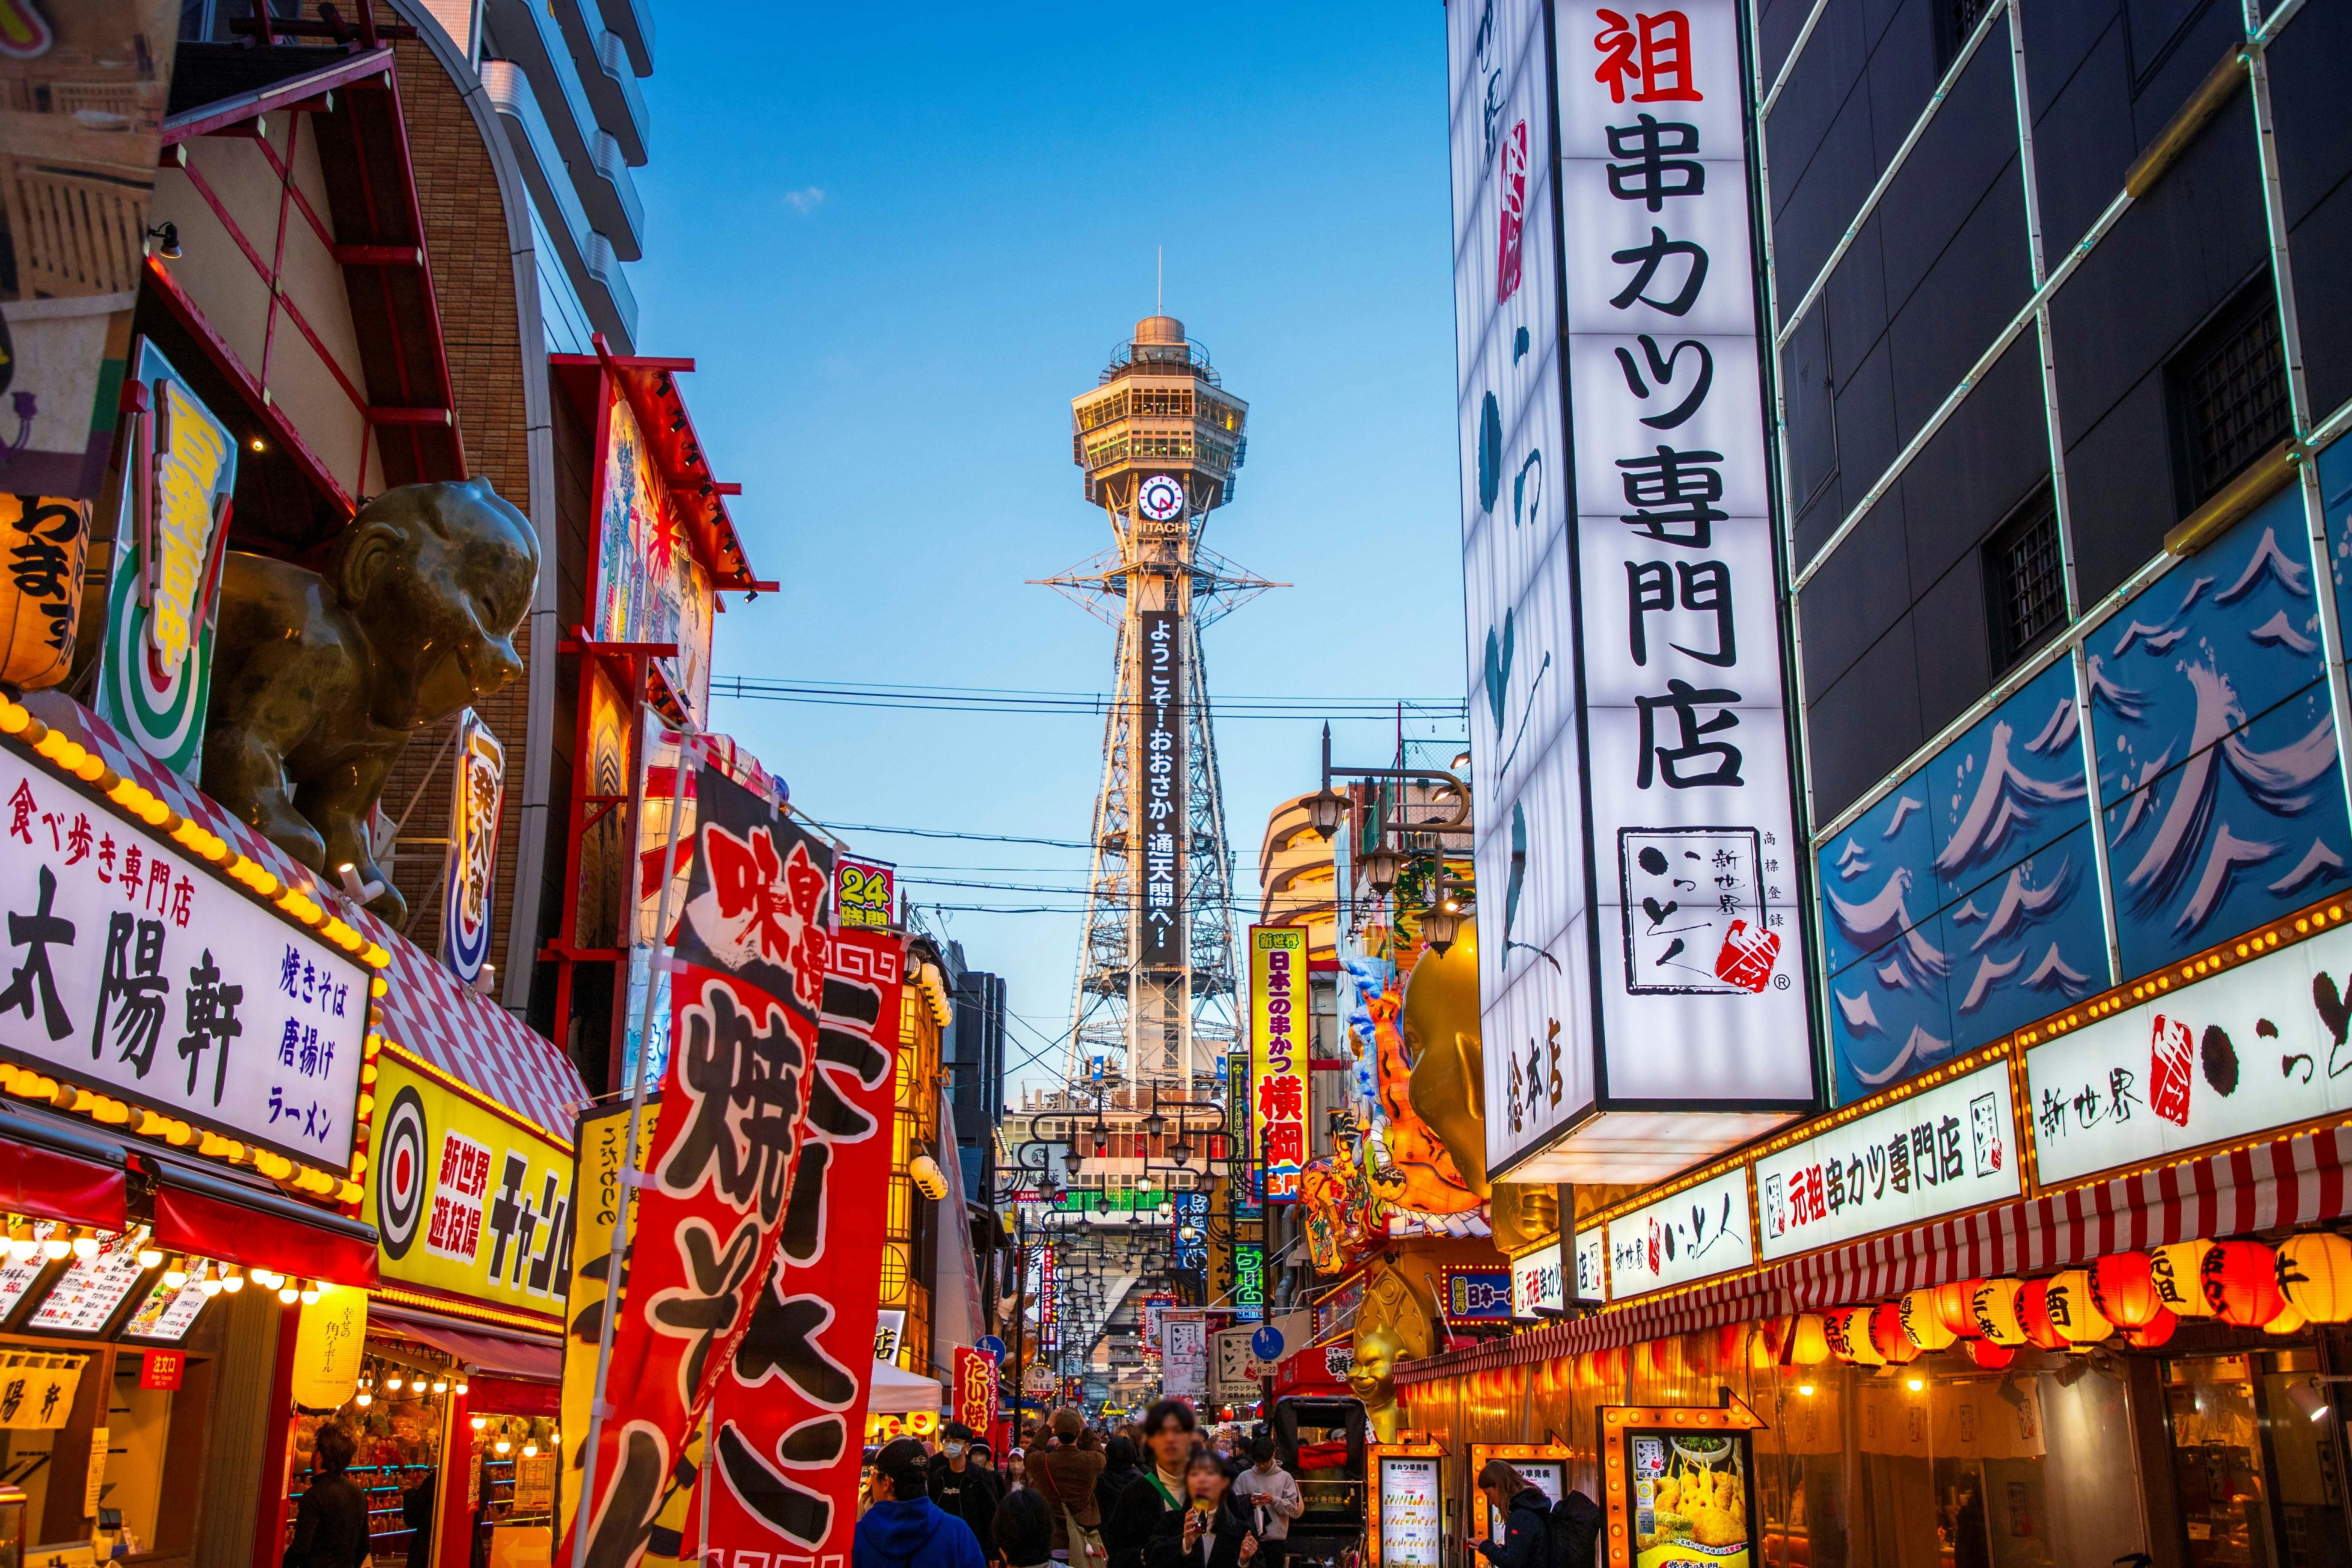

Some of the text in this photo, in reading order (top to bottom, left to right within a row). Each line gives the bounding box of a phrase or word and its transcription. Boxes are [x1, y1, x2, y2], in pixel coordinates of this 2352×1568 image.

[1594, 8, 1745, 790] 祖串カツ専門店
[1132, 523, 1190, 534] HITACHI
[8, 778, 194, 928] 食べ歩き専門店
[1712, 850, 1745, 915] 新世界
[1763, 832, 1783, 927] 商標登録
[839, 867, 890, 909] 24
[1259, 932, 1300, 951] 新世界
[0, 864, 244, 1107] 太陽軒
[279, 943, 348, 1019] 焼きそば
[1267, 951, 1293, 1073] 日本一の串かつ
[278, 1016, 334, 1080] 唐揚げ
[269, 1087, 332, 1143] ラーメン
[1259, 1075, 1303, 1166] 横綱
[2039, 1067, 2142, 1146] 新世界
[439, 1136, 490, 1199] 新世界
[1789, 1115, 1964, 1228] 元祖串カツ専門店
[427, 1197, 481, 1259] 遊技場
[1615, 1238, 1646, 1270] 新世界
[341, 1307, 354, 1337] 幸せの
[1455, 1279, 1465, 1314] 新世界
[1900, 1297, 1922, 1345] 通天閣
[153, 1355, 176, 1373] 注文口
[323, 1322, 339, 1372] 角ハイボール
